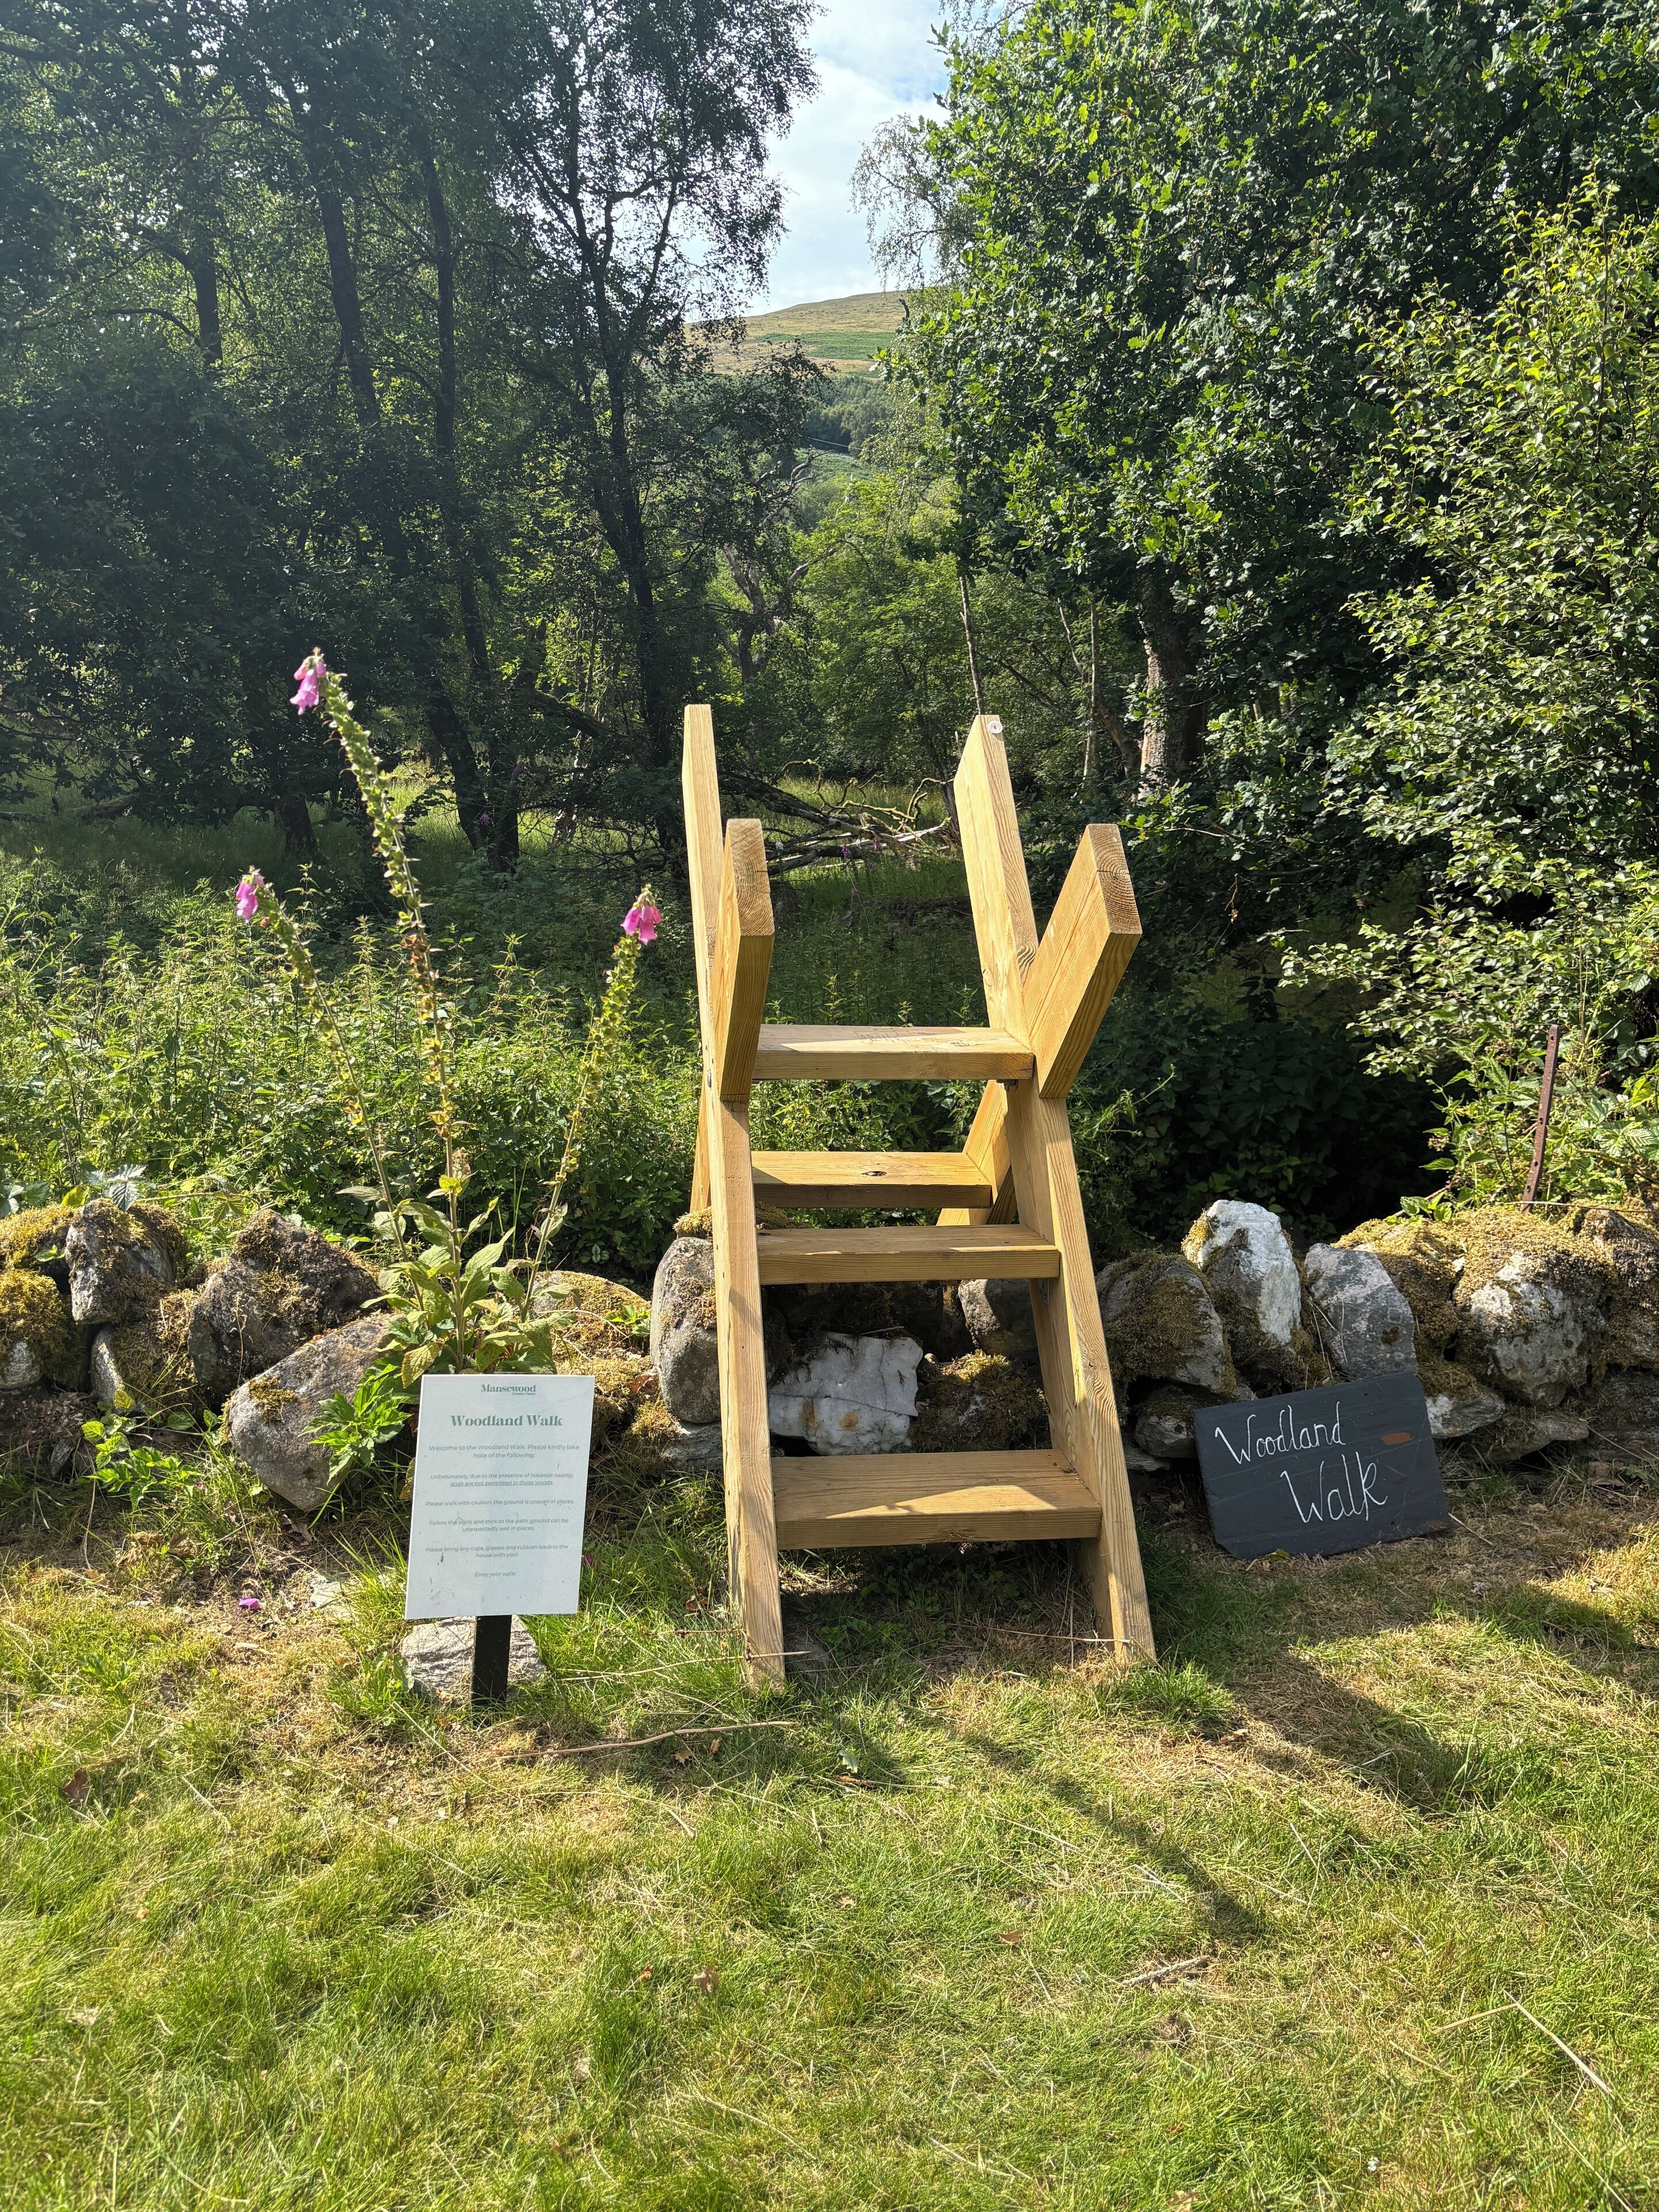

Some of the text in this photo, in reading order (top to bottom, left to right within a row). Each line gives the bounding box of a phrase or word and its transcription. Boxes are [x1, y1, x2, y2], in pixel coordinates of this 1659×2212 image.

[480, 1384, 536, 1392] Mansewood
[451, 1414, 563, 1426] Woodland Walk
[1214, 1401, 1346, 1465] Woodland
[1279, 1451, 1388, 1524] Walk
